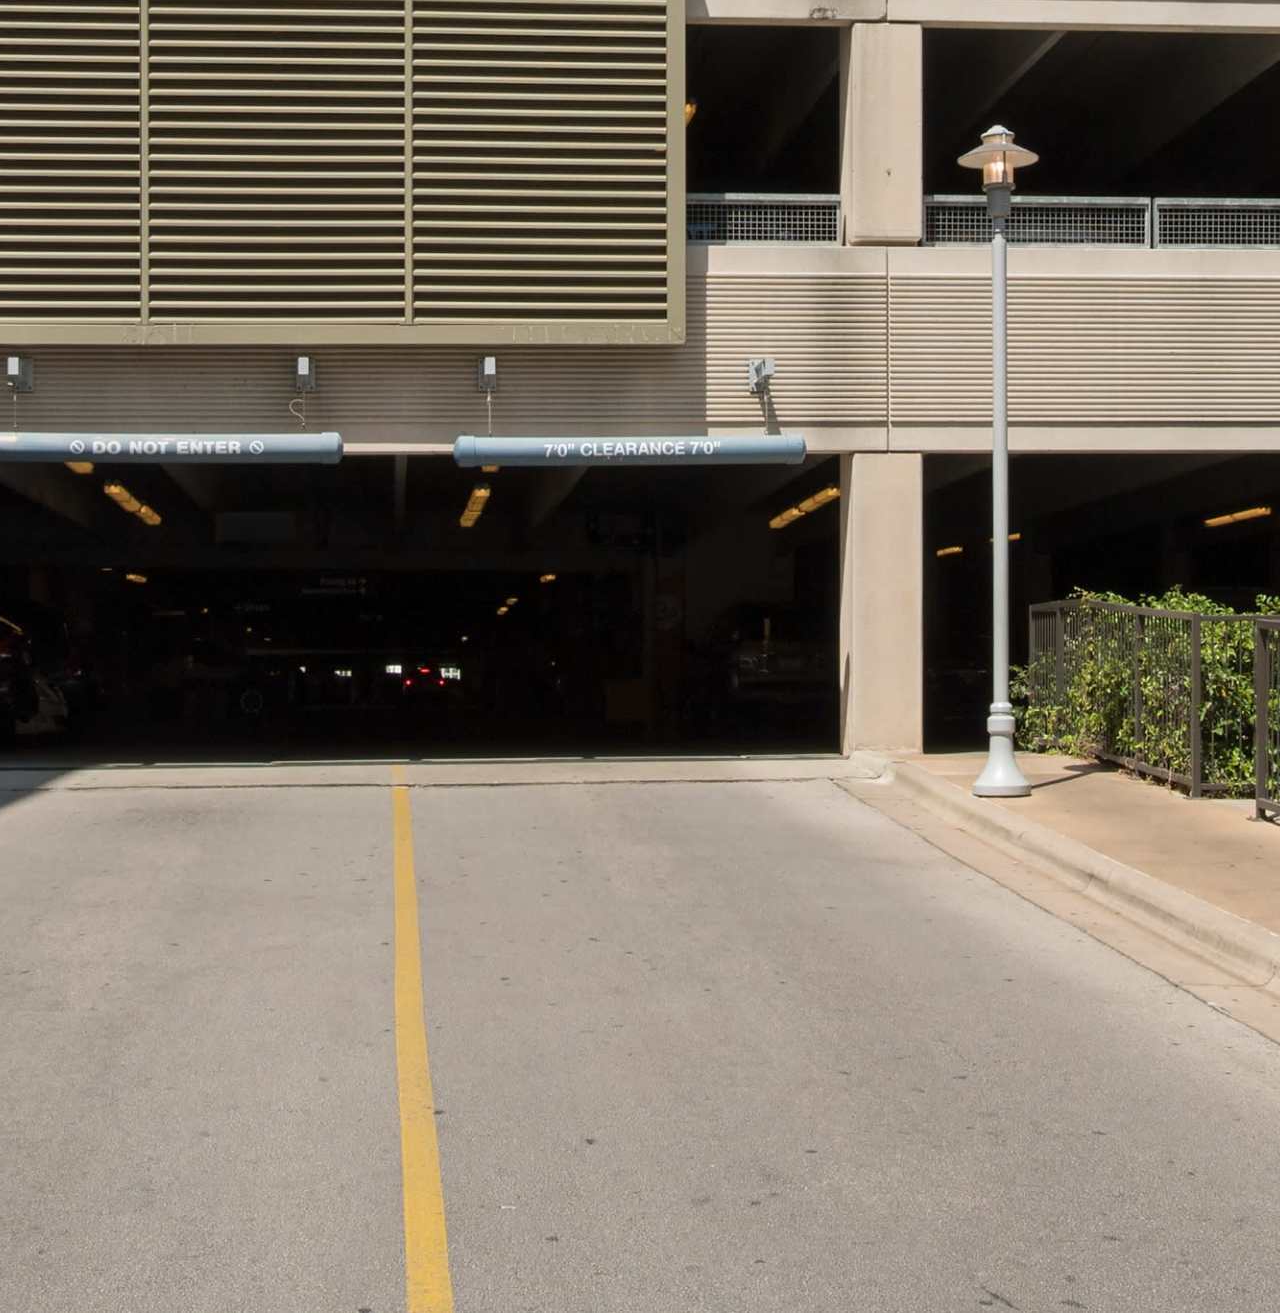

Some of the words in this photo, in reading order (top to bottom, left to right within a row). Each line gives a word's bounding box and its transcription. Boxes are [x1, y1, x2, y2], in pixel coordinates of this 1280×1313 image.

[92, 440, 121, 454] DO
[129, 440, 169, 455] NOT
[176, 440, 241, 455] ENTER
[579, 441, 686, 457] CLEARANCE
